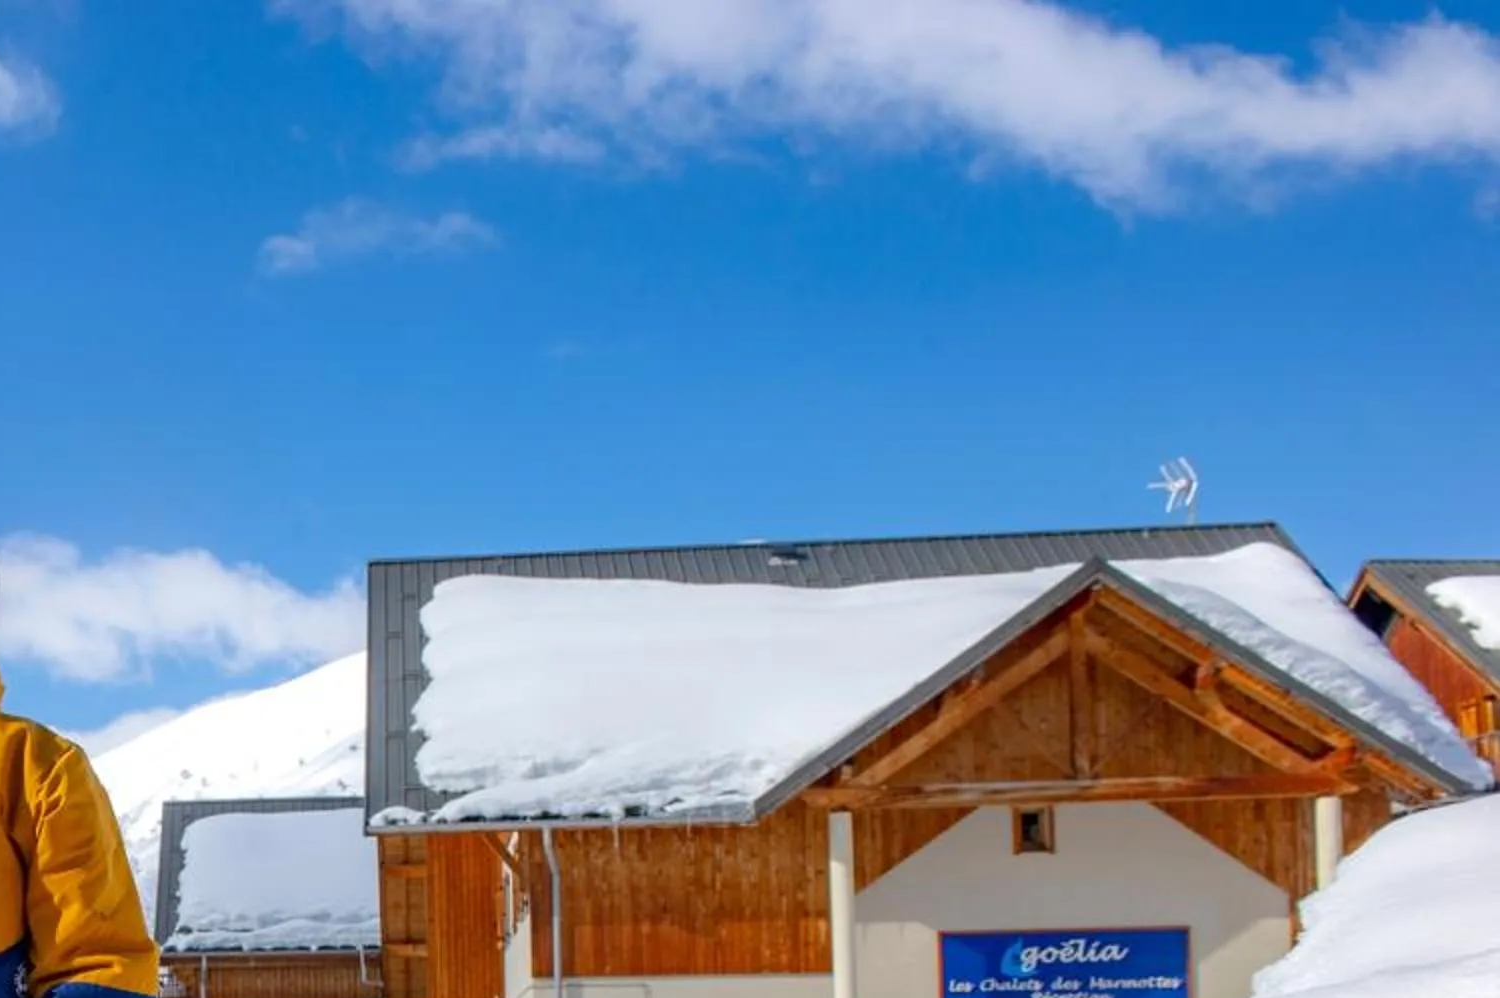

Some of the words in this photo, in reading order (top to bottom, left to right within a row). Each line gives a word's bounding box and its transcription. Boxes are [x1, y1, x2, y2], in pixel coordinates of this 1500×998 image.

[950, 978, 974, 993] Les
[979, 977, 1044, 992] Chalets
[1051, 976, 1082, 991] des
[1089, 975, 1183, 990] Marmottes
